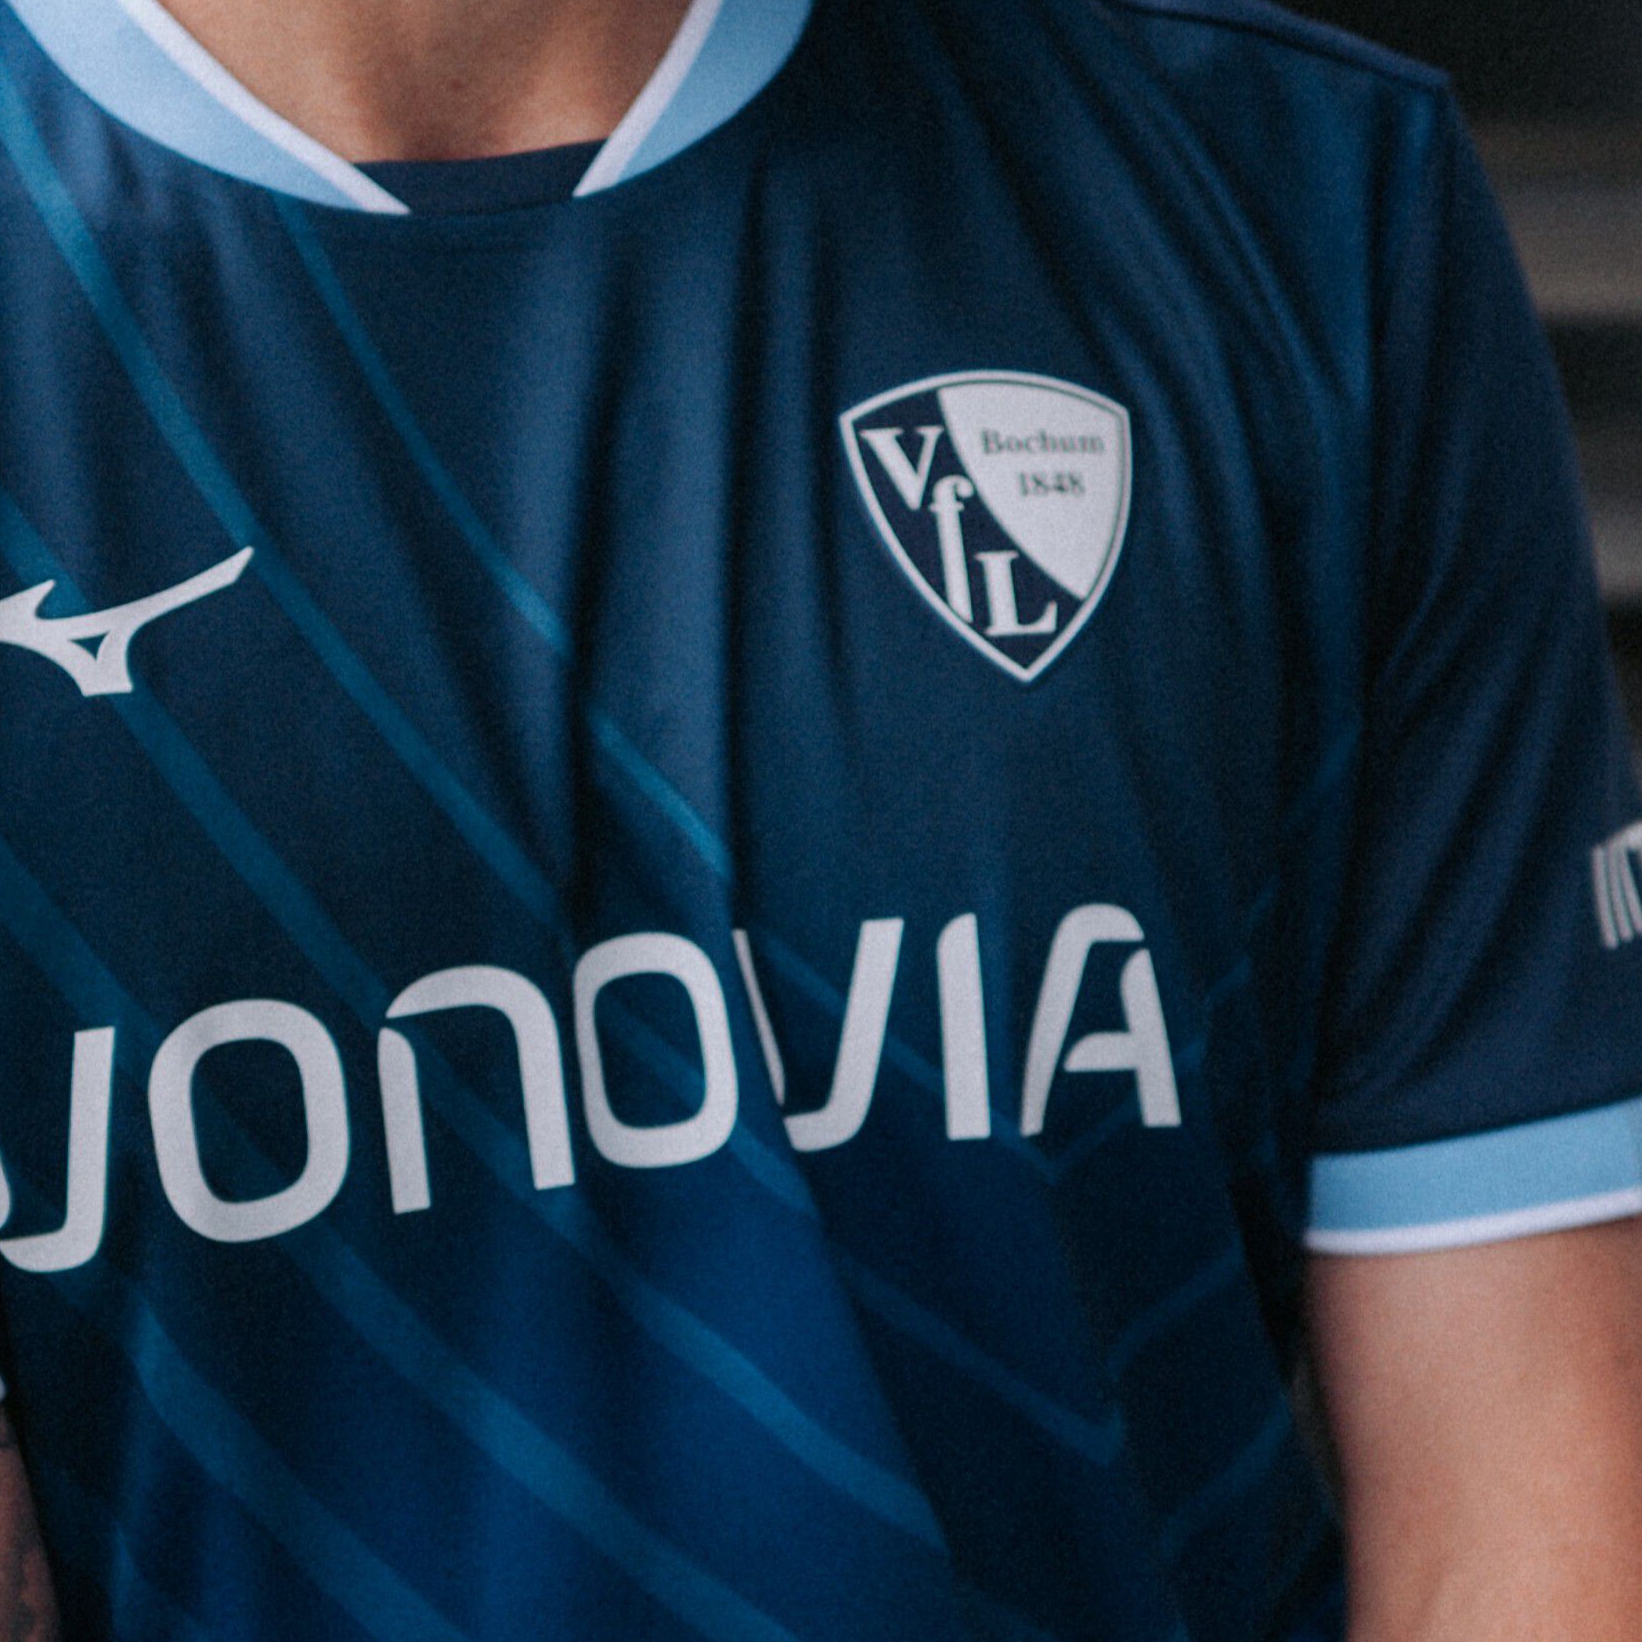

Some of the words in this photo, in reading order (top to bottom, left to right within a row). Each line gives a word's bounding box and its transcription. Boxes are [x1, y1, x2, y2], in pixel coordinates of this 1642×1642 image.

[981, 428, 1106, 455] Bochum
[1018, 470, 1086, 497] 1848
[859, 426, 1057, 637] VfL
